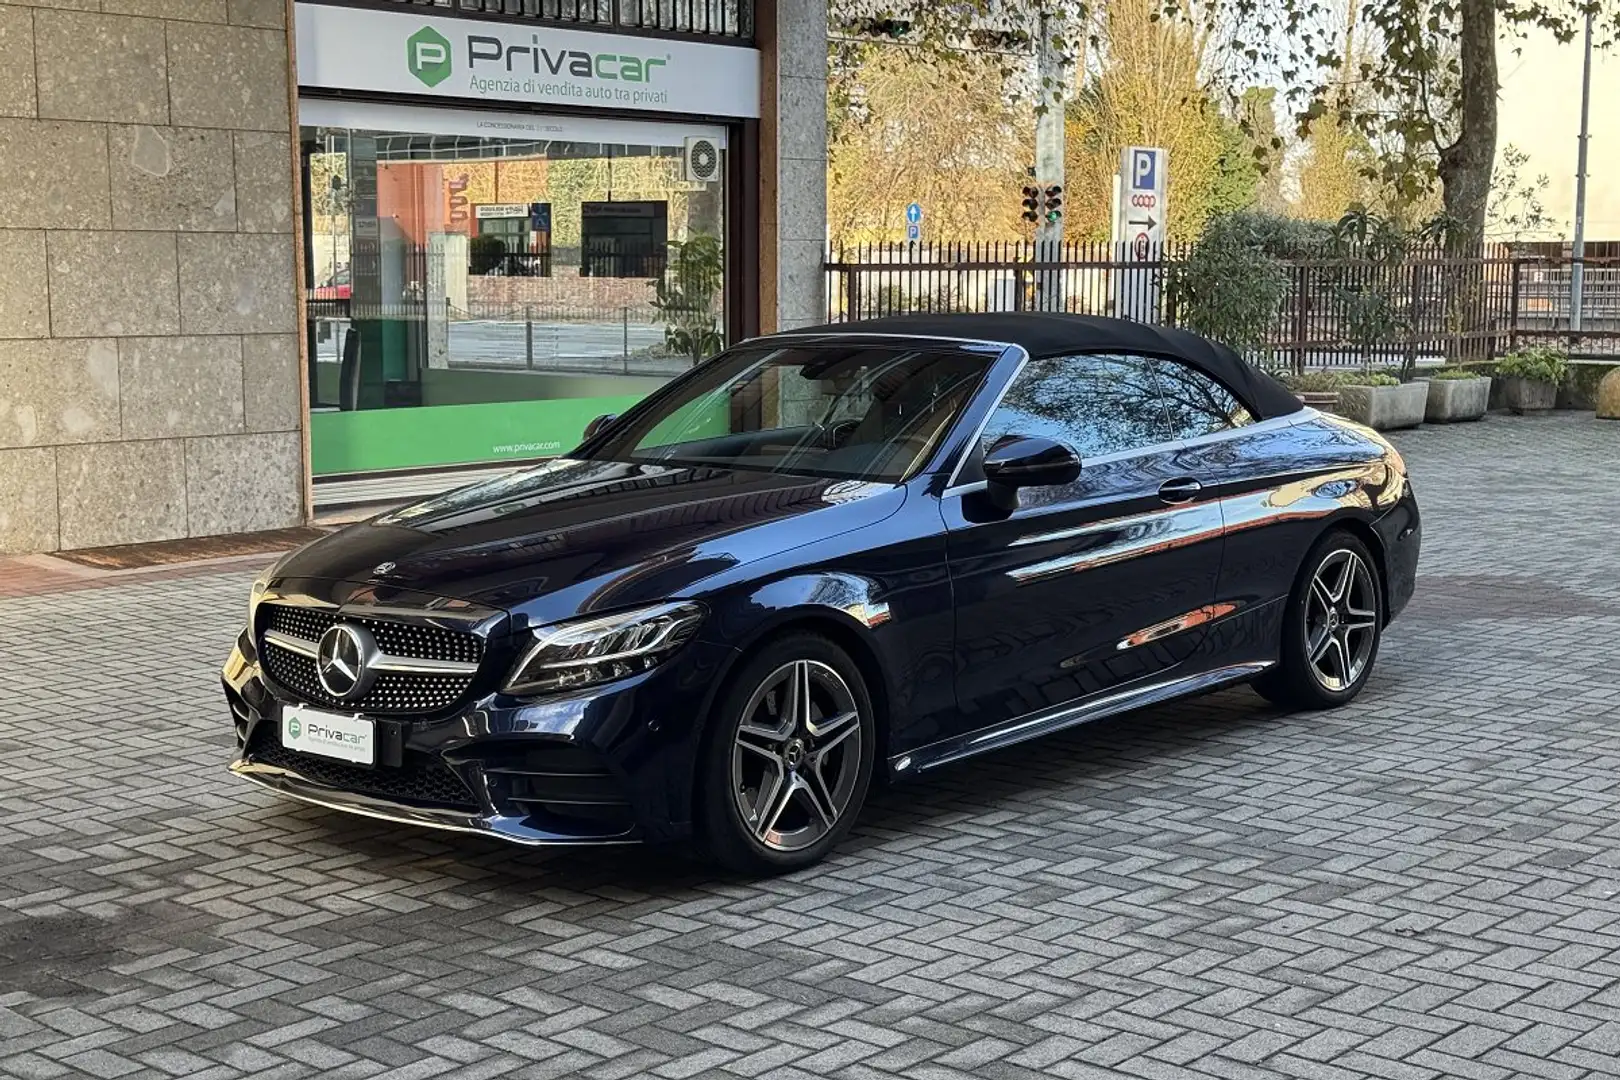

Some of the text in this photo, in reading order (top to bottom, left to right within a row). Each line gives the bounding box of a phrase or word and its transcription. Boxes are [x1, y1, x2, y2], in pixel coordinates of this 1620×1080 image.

[416, 42, 446, 70] P
[467, 34, 668, 83] Privacar
[469, 75, 668, 105] Agenzia di vendita auto tra privati
[1136, 153, 1151, 186] P
[1132, 194, 1156, 210] coop
[910, 227, 917, 238] P
[492, 440, 561, 454] www.privacar.com
[308, 723, 367, 744] Privacar
